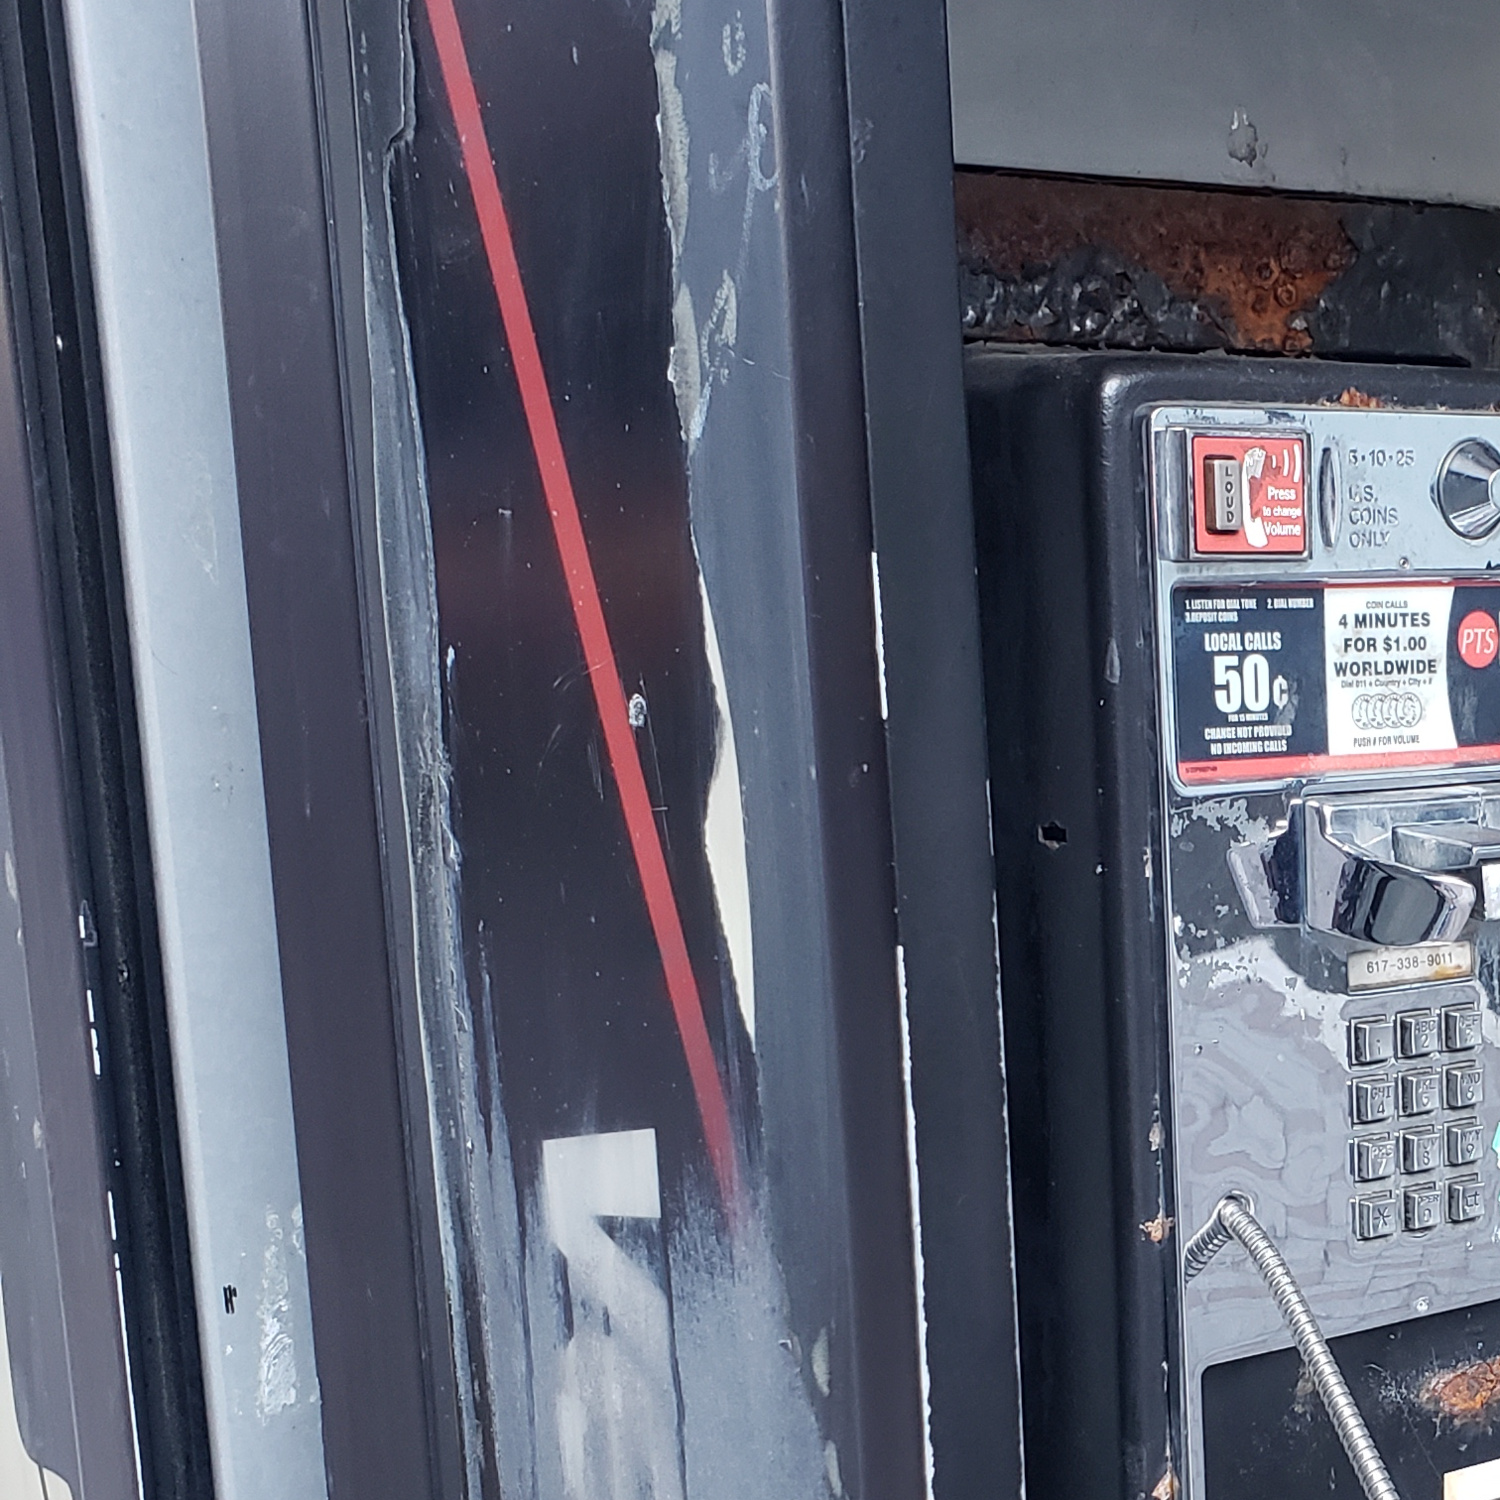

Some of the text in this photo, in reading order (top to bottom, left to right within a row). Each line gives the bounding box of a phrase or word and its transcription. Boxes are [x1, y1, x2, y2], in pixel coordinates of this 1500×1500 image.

[1225, 466, 1235, 524] LOUD
[1267, 485, 1297, 501] Press
[1262, 505, 1302, 519] to change
[1349, 506, 1398, 525] COINS
[1263, 521, 1302, 536] Volume
[1349, 530, 1391, 548] ONLY
[1385, 600, 1408, 609] CALLS
[1339, 612, 1430, 628] 4 MINUTES
[1204, 631, 1282, 651] LOCAL CALLS
[1344, 634, 1427, 655] FOR $1.00
[1461, 628, 1495, 654] PTS
[1334, 659, 1437, 677] WORLDWIDE
[1214, 653, 1289, 713] 50¢
[1205, 726, 1236, 740] CHANGE
[1237, 725, 1252, 739] NOT
[1211, 739, 1287, 755] NO INCOMING CALLS
[1367, 952, 1453, 974] 617-338-9011
[1423, 1151, 1430, 1165] 8
[1466, 1143, 1475, 1159] 9
